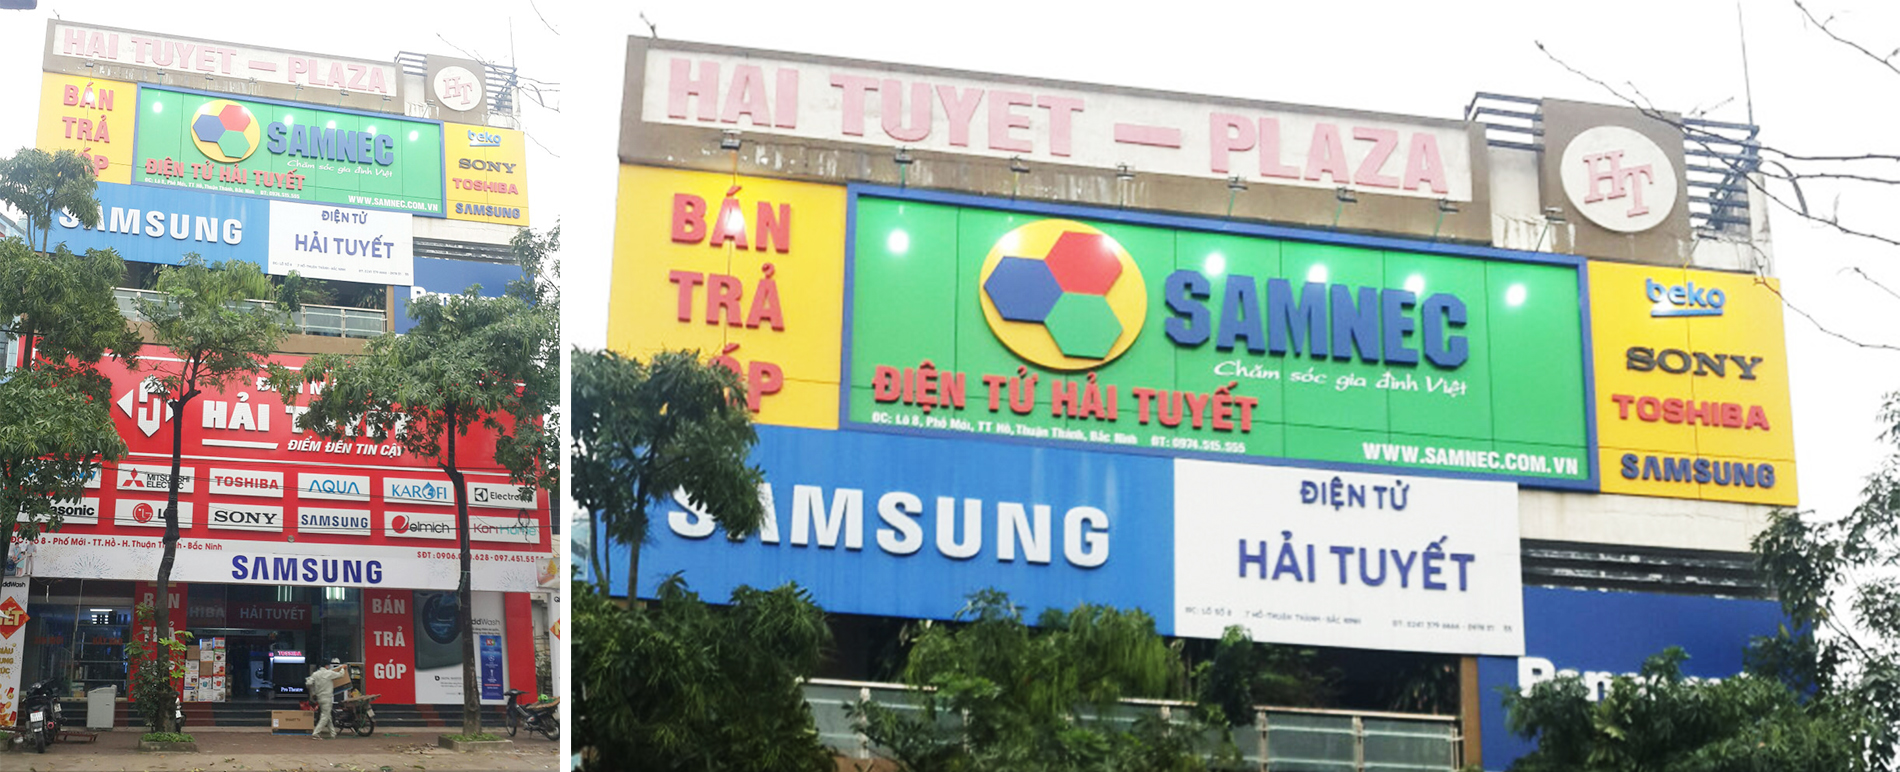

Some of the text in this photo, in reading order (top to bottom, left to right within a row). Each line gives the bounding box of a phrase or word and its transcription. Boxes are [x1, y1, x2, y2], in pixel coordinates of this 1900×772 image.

[63, 28, 119, 60] HAI
[131, 36, 237, 74] TUYET
[288, 56, 388, 94] PLAZA
[63, 82, 114, 111] BÁN
[62, 114, 110, 143] TRẢ
[467, 129, 502, 144] beko
[667, 57, 799, 130] HAI
[829, 72, 1085, 157] TUYET
[1209, 111, 1448, 194] PLAZA
[267, 121, 394, 166] SAMNEC
[145, 156, 306, 191] ĐIỆN TỬ HẢI TUYẾT
[458, 158, 517, 174] SONY
[452, 177, 519, 195] TOSHIBA
[1583, 148, 1655, 219] HT
[321, 209, 368, 224] ĐIỆN TỬ
[348, 195, 438, 212] WWW.SAMNEC.COM.VN
[455, 202, 521, 219] SAMSUNG
[671, 185, 791, 254] BÁN
[295, 231, 394, 259] HẢI TUYẾT
[669, 262, 785, 332] TRẢ
[1645, 278, 1726, 309] beko
[1164, 268, 1470, 371] SAMNEC
[1625, 346, 1764, 380] SONY
[1213, 359, 1468, 399] Chăm sóc gia đình Việt
[871, 360, 1258, 433] ĐIỆN TỬ HẢI TUYẾT
[202, 391, 270, 432] HẢI
[1611, 393, 1770, 431] TOSHIBA
[287, 435, 322, 453] ĐIỂM
[356, 443, 378, 456] TIN
[1362, 441, 1579, 476] WWW.SAMNEC.COM.VN
[214, 475, 279, 490] TOSHIBA
[1620, 453, 1776, 489] SAMSUNG
[309, 479, 360, 495] AQUA
[1300, 476, 1410, 511] ĐIỆN TỬ
[213, 510, 278, 525] SONY
[301, 514, 369, 529] SAMSUNG
[409, 521, 450, 534] elmich
[53, 536, 70, 546] Phố
[205, 543, 222, 551] Ninh
[231, 554, 382, 584] SAMSUNG
[1238, 530, 1476, 592] HẢI TUYẾT
[240, 604, 305, 620] HẢI TUYẾT
[372, 594, 406, 615] BÁN
[373, 625, 406, 647] TRẢ
[373, 659, 407, 680] GÓP
